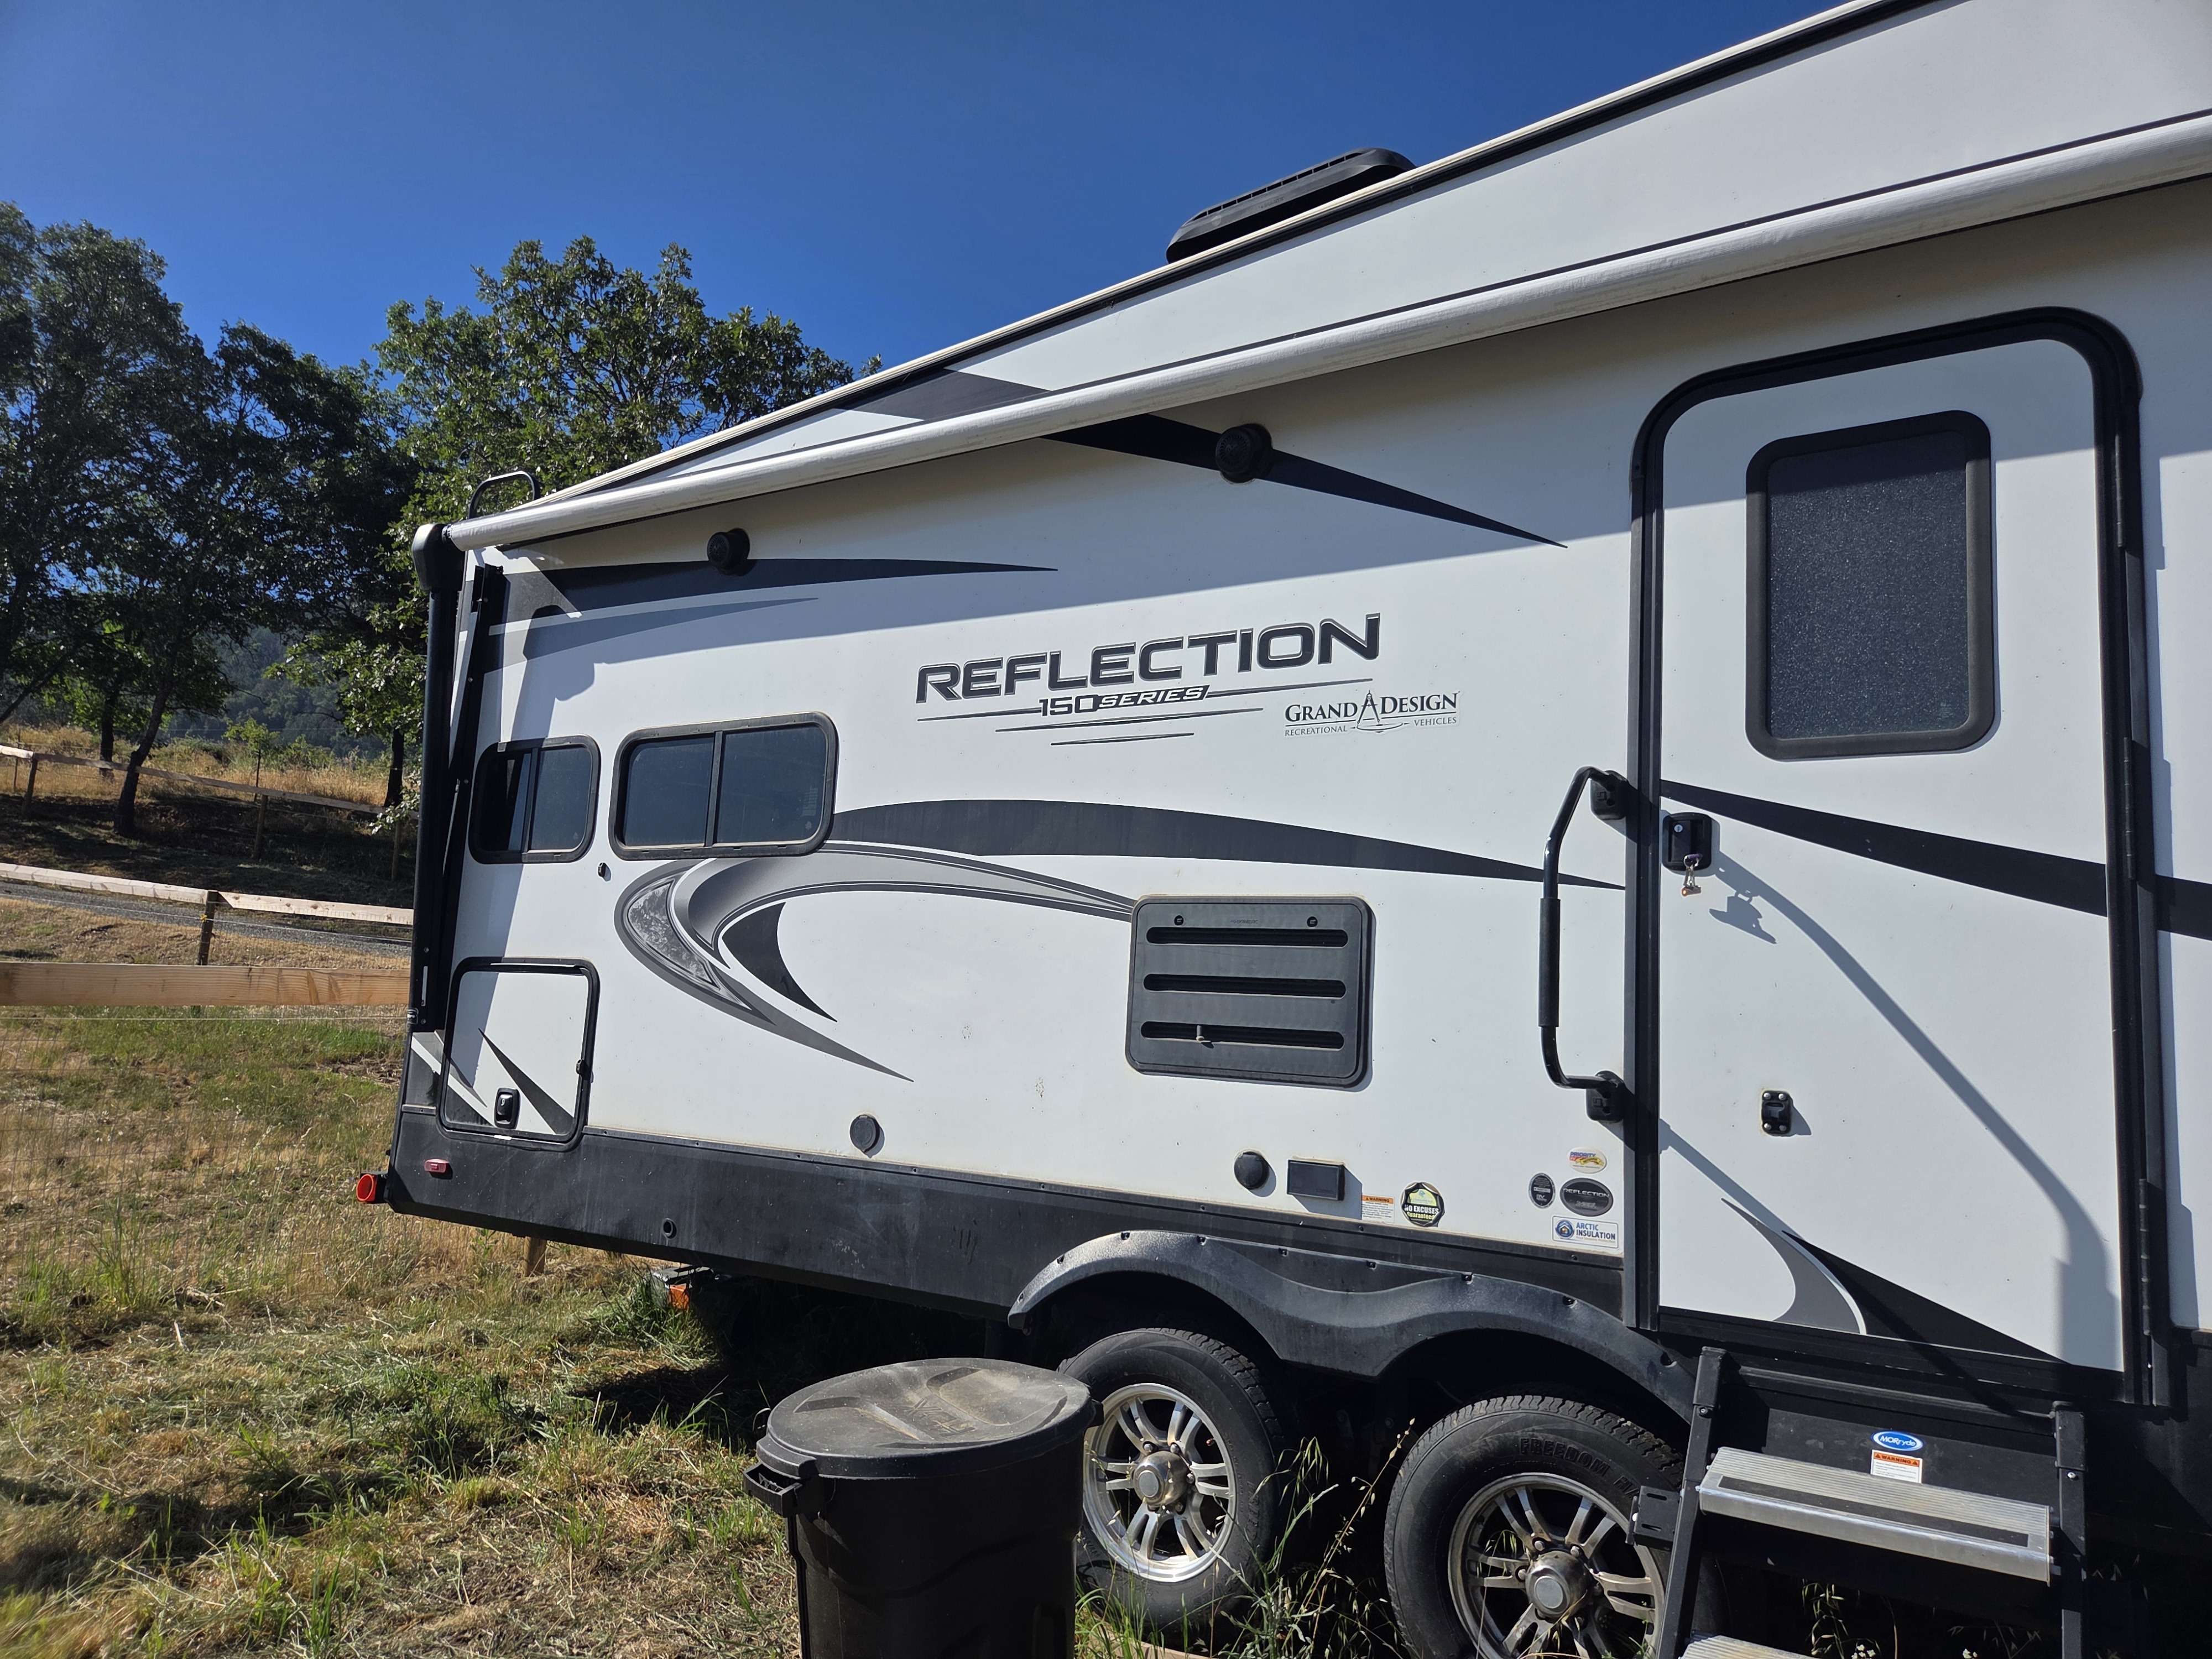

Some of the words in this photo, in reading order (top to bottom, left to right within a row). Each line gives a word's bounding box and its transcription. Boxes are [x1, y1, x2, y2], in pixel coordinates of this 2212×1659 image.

[916, 613, 1380, 703] REFLECTION
[1039, 694, 1099, 716] 150
[1099, 687, 1204, 708] SERIES
[1285, 702, 1358, 722] GRAND
[1380, 693, 1458, 715] DESIGN
[1285, 726, 1348, 737] RECREATIONAL
[1413, 717, 1457, 727] VEHICLES
[1563, 1188, 1610, 1198] REFLECTION
[1413, 1206, 1439, 1214] EXCUSES
[1576, 1222, 1599, 1231] ARCTIC
[1576, 1229, 1616, 1240] INSULATION
[1520, 1437, 1611, 1477] FREEDOM
[1881, 1455, 1912, 1464] WARNING
